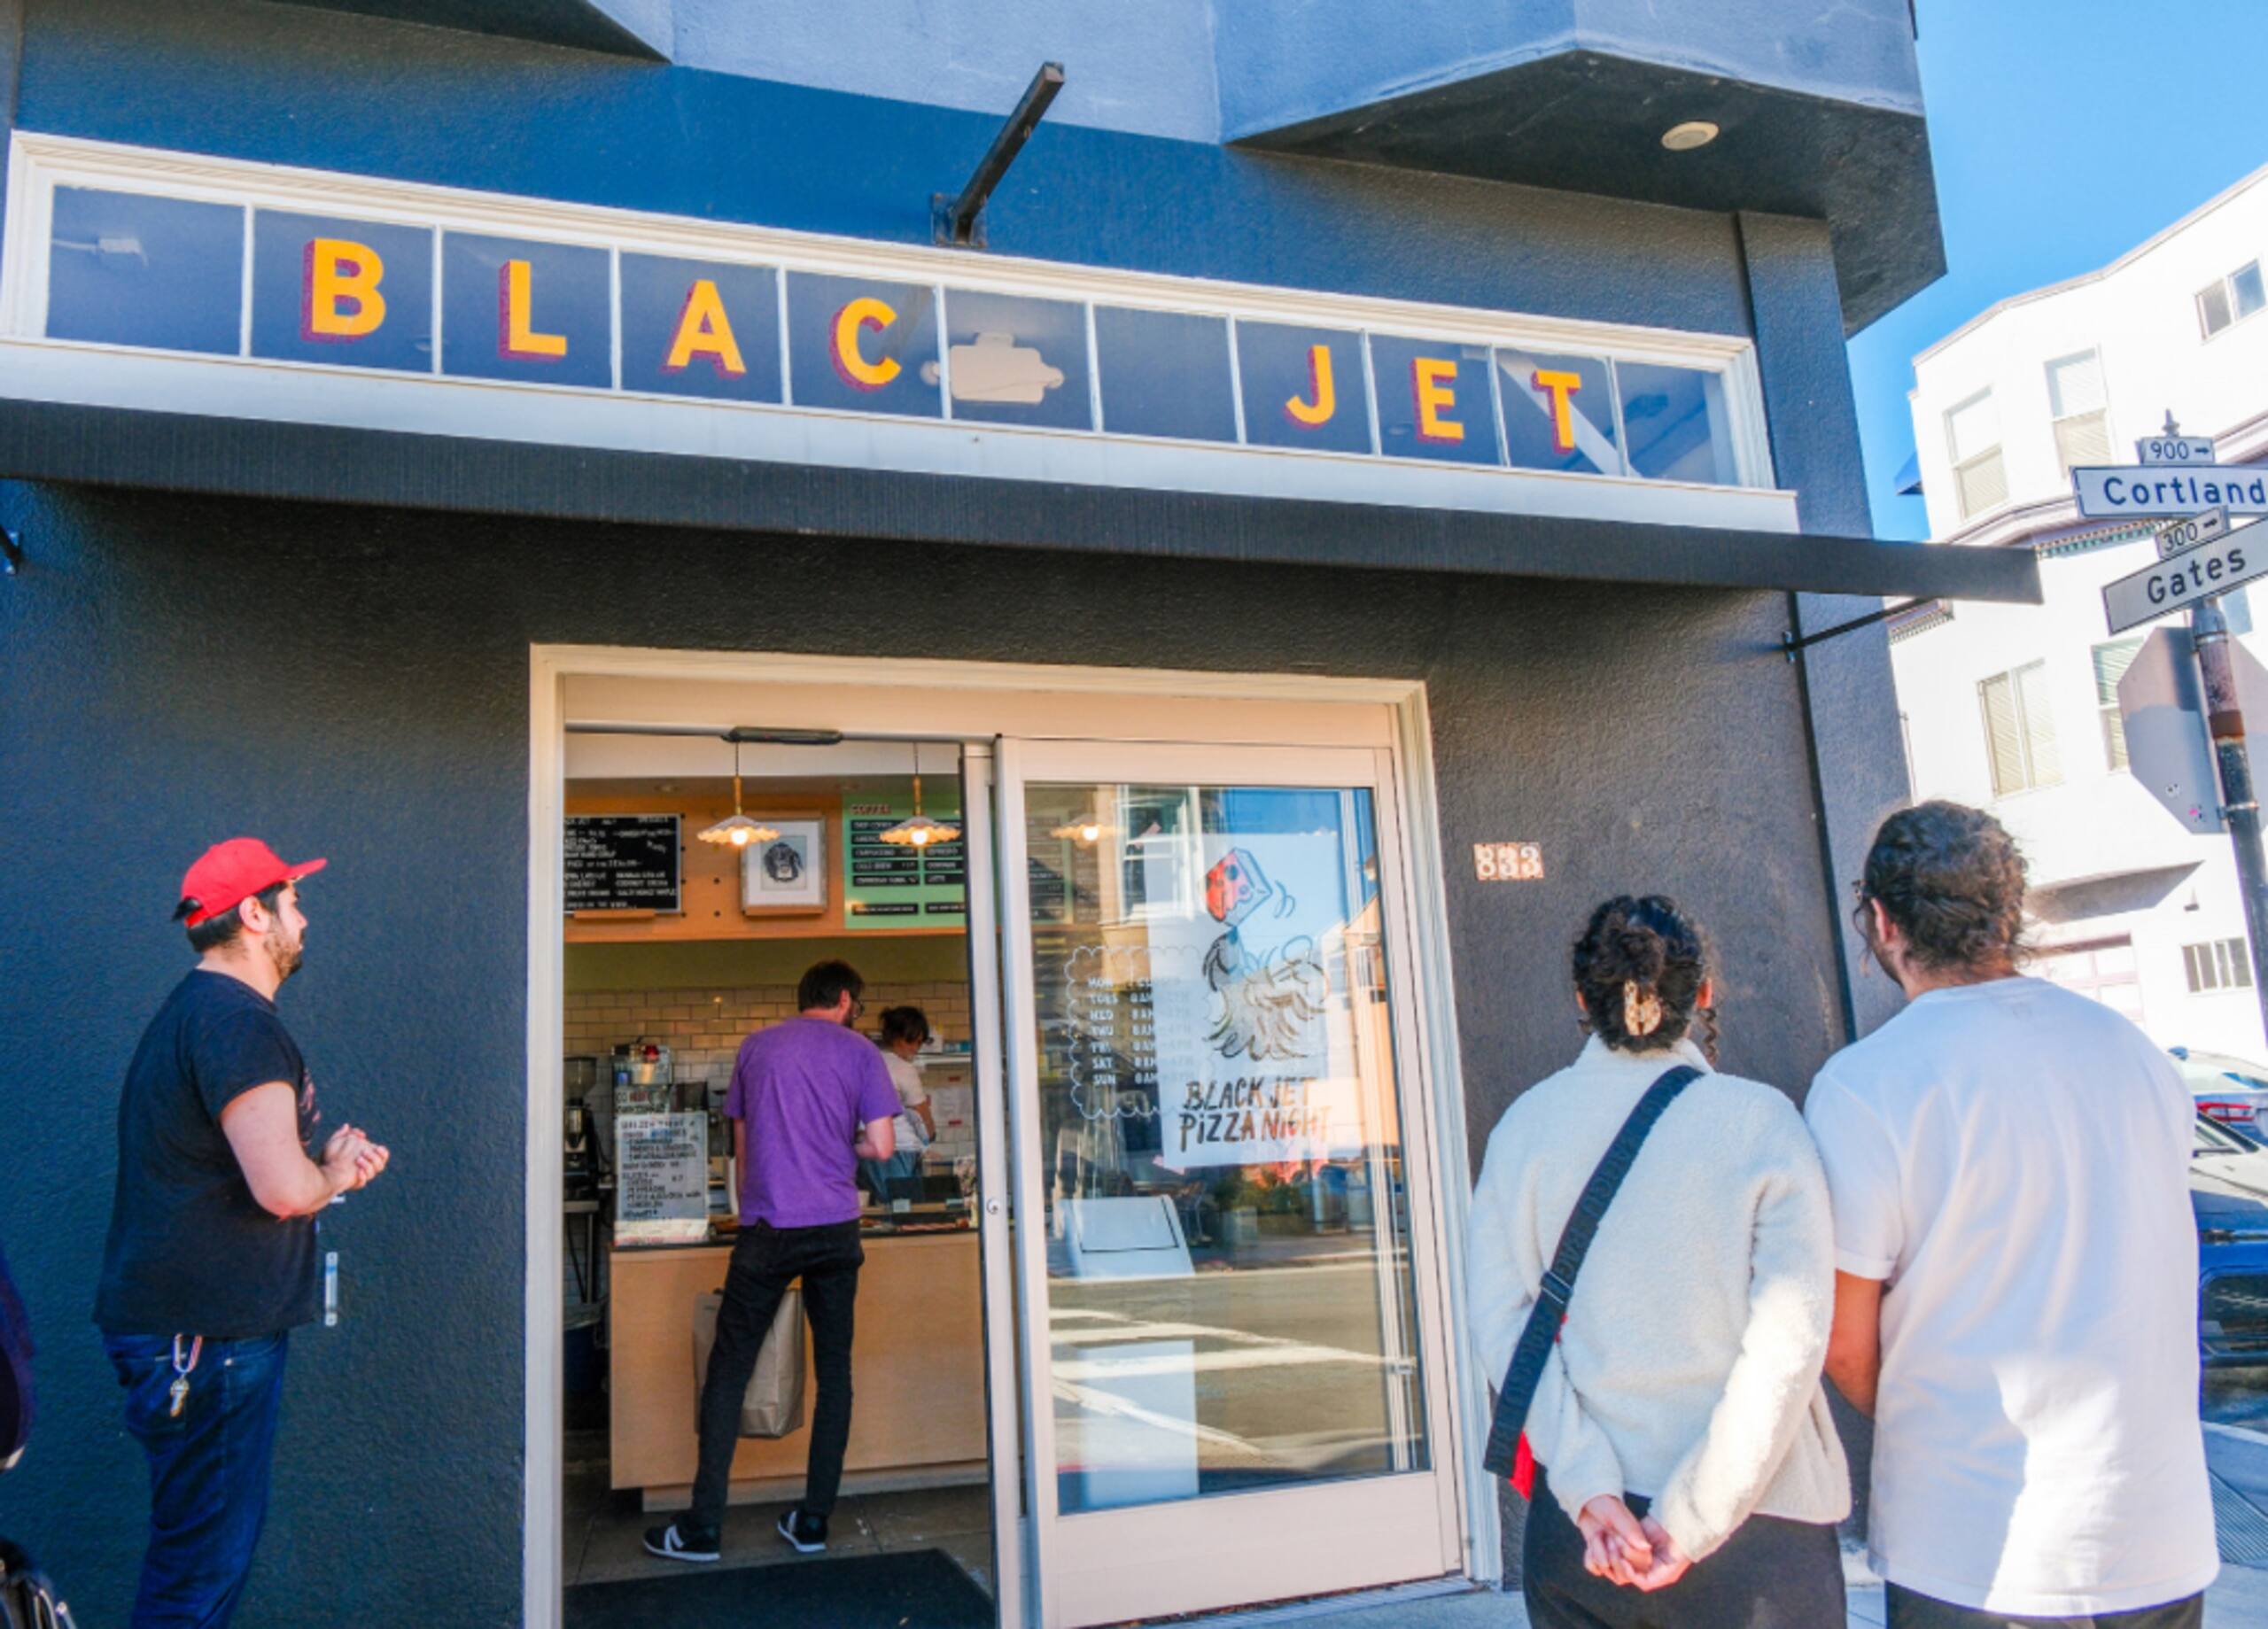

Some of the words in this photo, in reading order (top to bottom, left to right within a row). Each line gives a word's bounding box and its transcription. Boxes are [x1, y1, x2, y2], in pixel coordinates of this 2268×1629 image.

[1285, 344, 1581, 454] JET
[2149, 440, 2190, 460] 900
[2102, 476, 2266, 506] Cortland
[2163, 522, 2198, 552] 300
[2147, 547, 2246, 604] Gates
[1183, 1076, 1264, 1111] BLACK
[1270, 1076, 1318, 1109] JET
